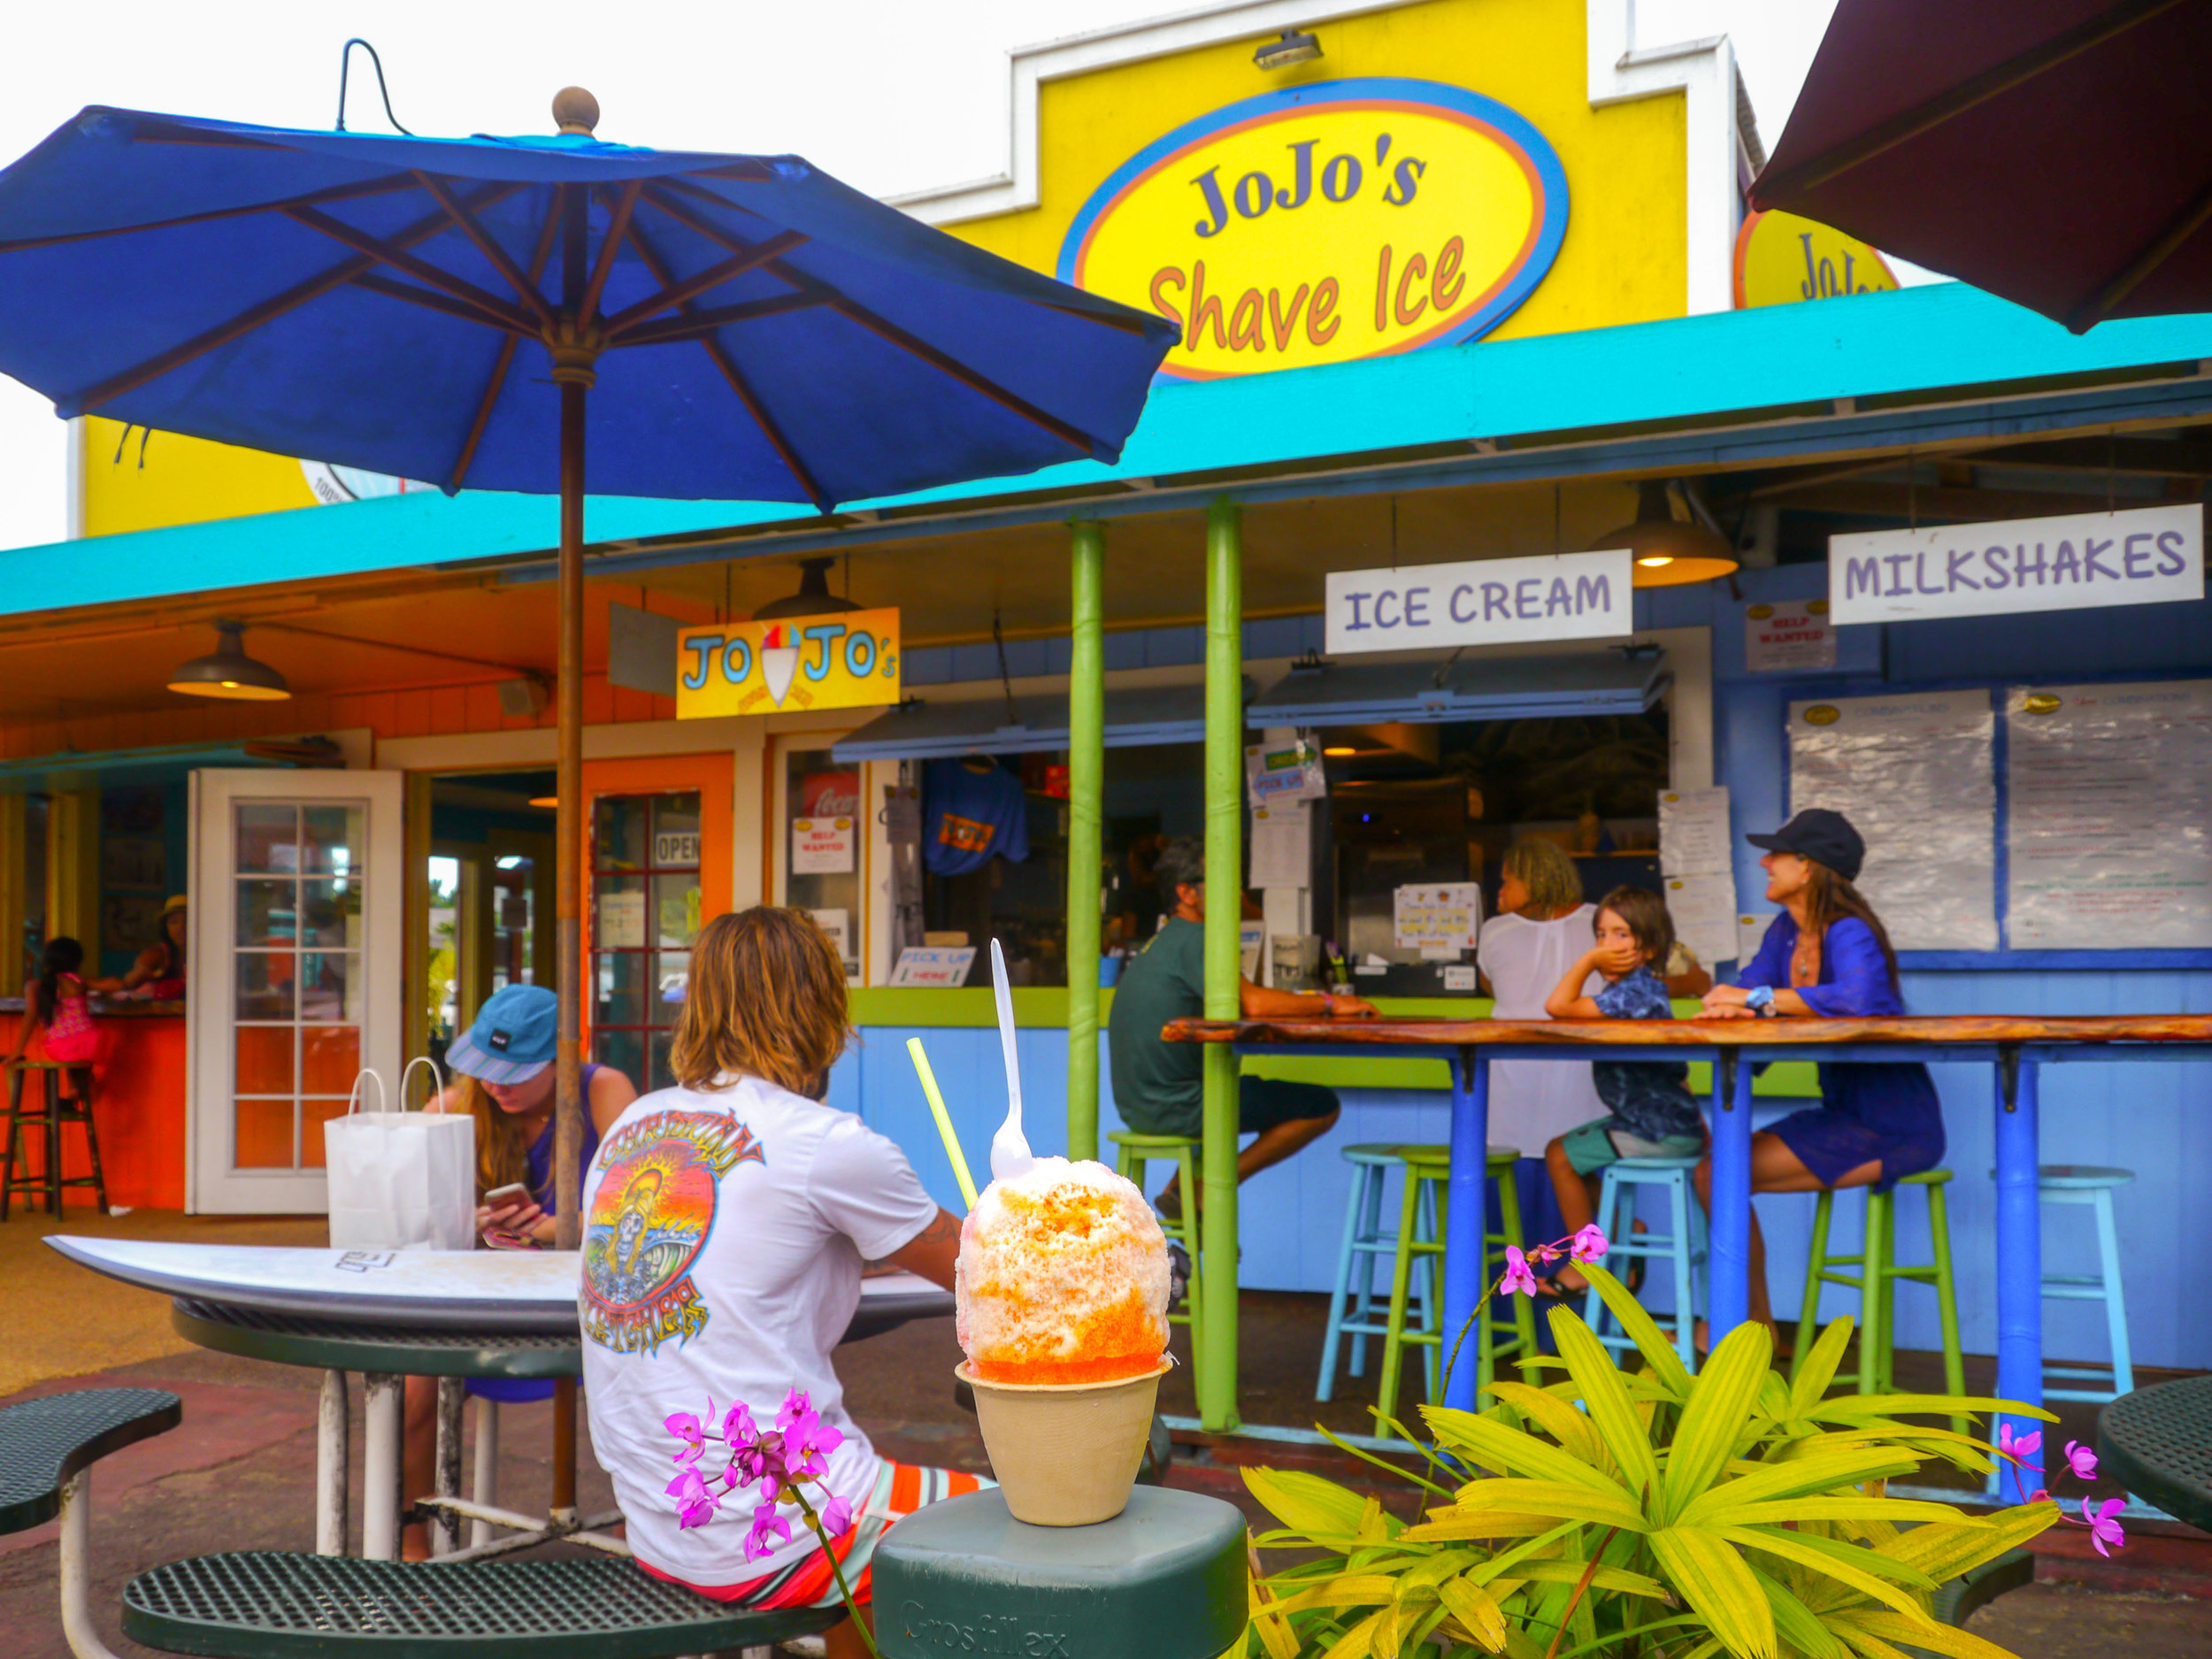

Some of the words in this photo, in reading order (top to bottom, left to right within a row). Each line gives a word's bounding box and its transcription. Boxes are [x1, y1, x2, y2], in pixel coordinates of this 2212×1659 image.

[1189, 133, 1427, 238] JoJo's
[1150, 259, 1340, 351] Shave
[1375, 235, 1465, 331] Ice
[1847, 531, 2185, 599] MILKSHAKES
[1345, 587, 1431, 631] ICE
[1449, 574, 1610, 623] CREAM
[1773, 616, 1810, 628] HELP
[1759, 629, 1824, 644] WANTED
[810, 830, 837, 841] HELP
[802, 841, 845, 852] WANTED
[901, 951, 941, 964] PICK
[949, 952, 972, 964] UP
